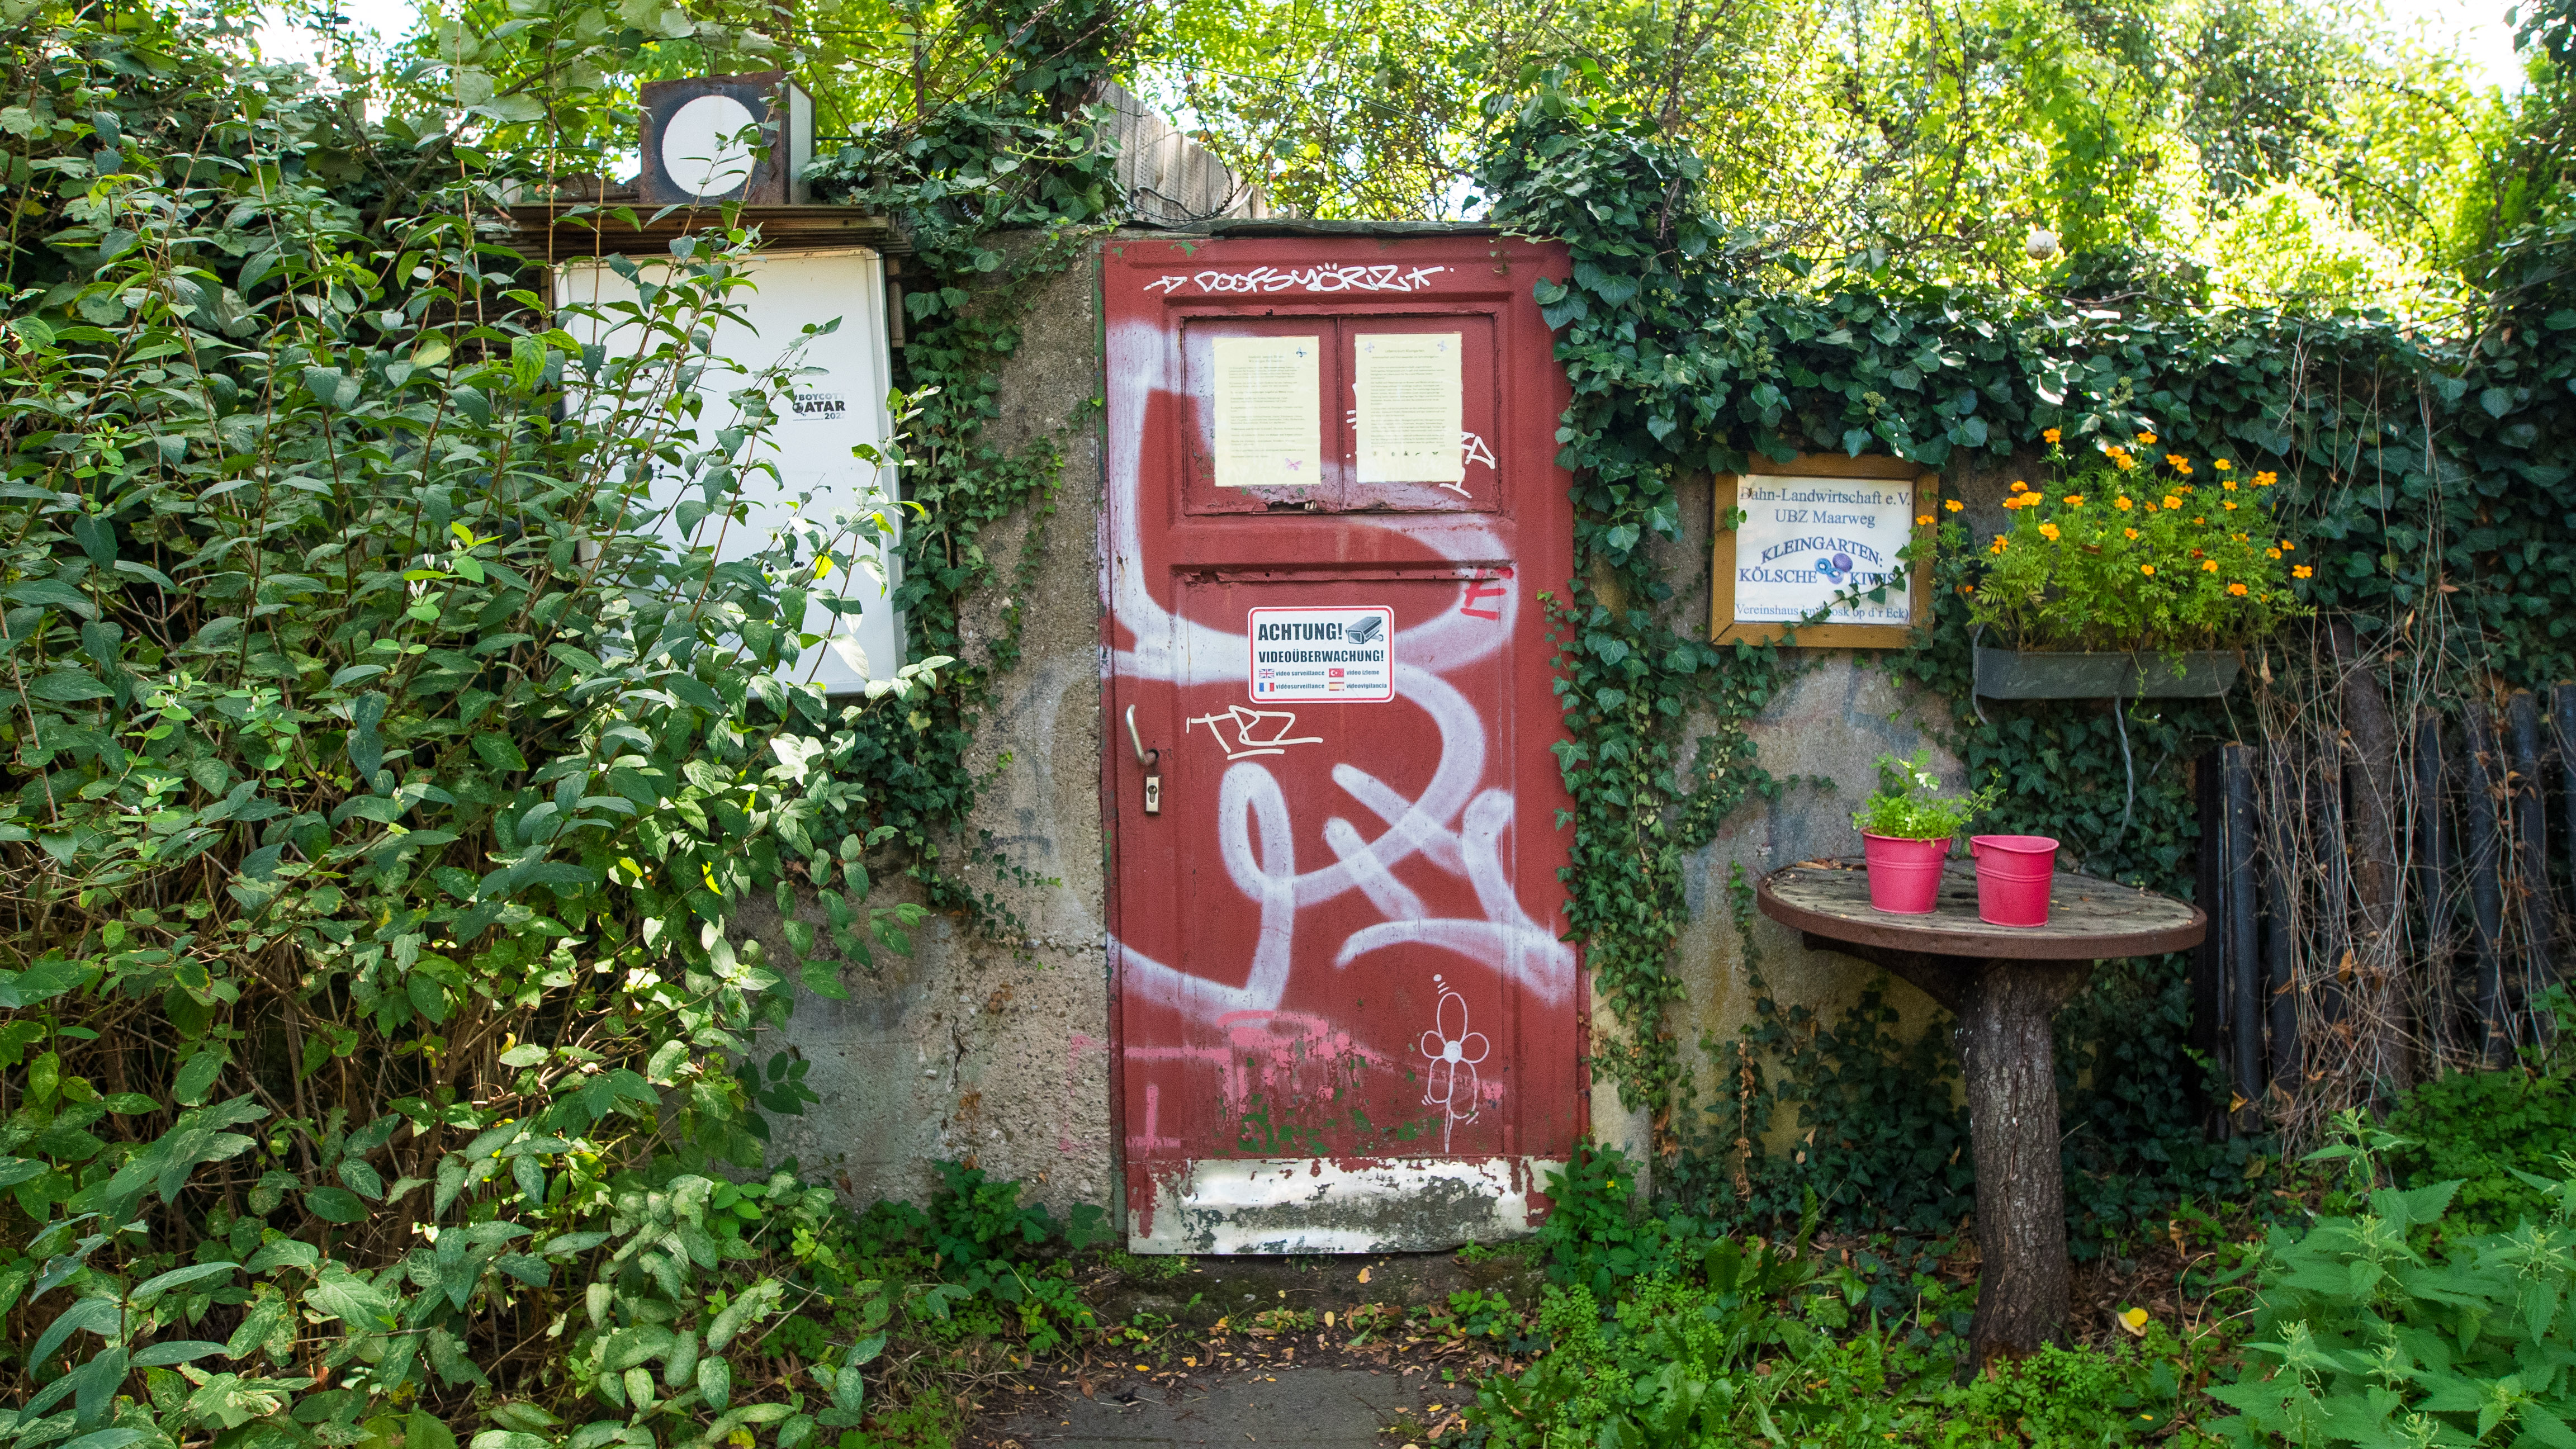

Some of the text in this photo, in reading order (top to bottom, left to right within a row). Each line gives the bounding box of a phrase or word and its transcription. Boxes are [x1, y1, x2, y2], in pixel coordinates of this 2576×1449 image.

[1739, 486, 1910, 505] Bahn-Landwirtschaft e. V.
[1775, 509, 1876, 528] UBZ Maarweg
[1761, 537, 1883, 567] KLEINGARTEN:
[1739, 566, 1817, 583] KÖLSCHE
[1736, 603, 1798, 615] Vereinshaus
[1887, 607, 1909, 621] Eck)
[1258, 623, 1343, 641] ACHTUNG!
[1258, 649, 1384, 662] VIDEOÜBERWACHUNG!
